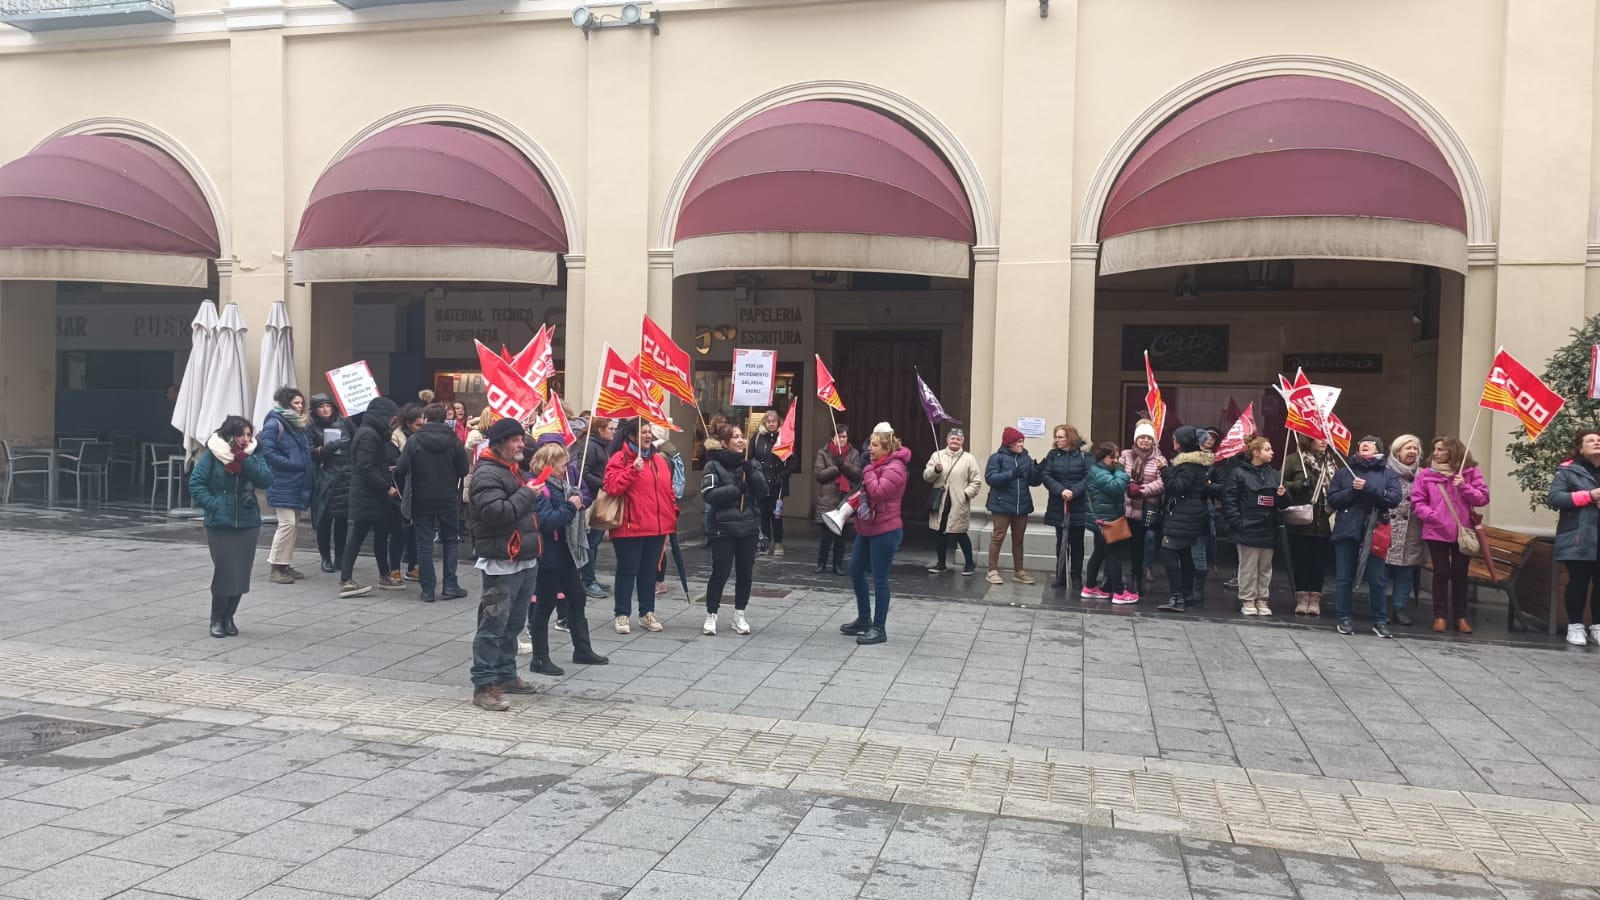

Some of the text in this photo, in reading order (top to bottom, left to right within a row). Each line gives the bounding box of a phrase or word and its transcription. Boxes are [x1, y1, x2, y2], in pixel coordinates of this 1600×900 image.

[435, 308, 534, 322] MATERIAL TECNICO
[739, 307, 802, 322] PAPELERIA
[55, 314, 88, 337] BAR
[436, 329, 499, 343] TOPOGRAFIA
[741, 330, 802, 345] ESCRITURA
